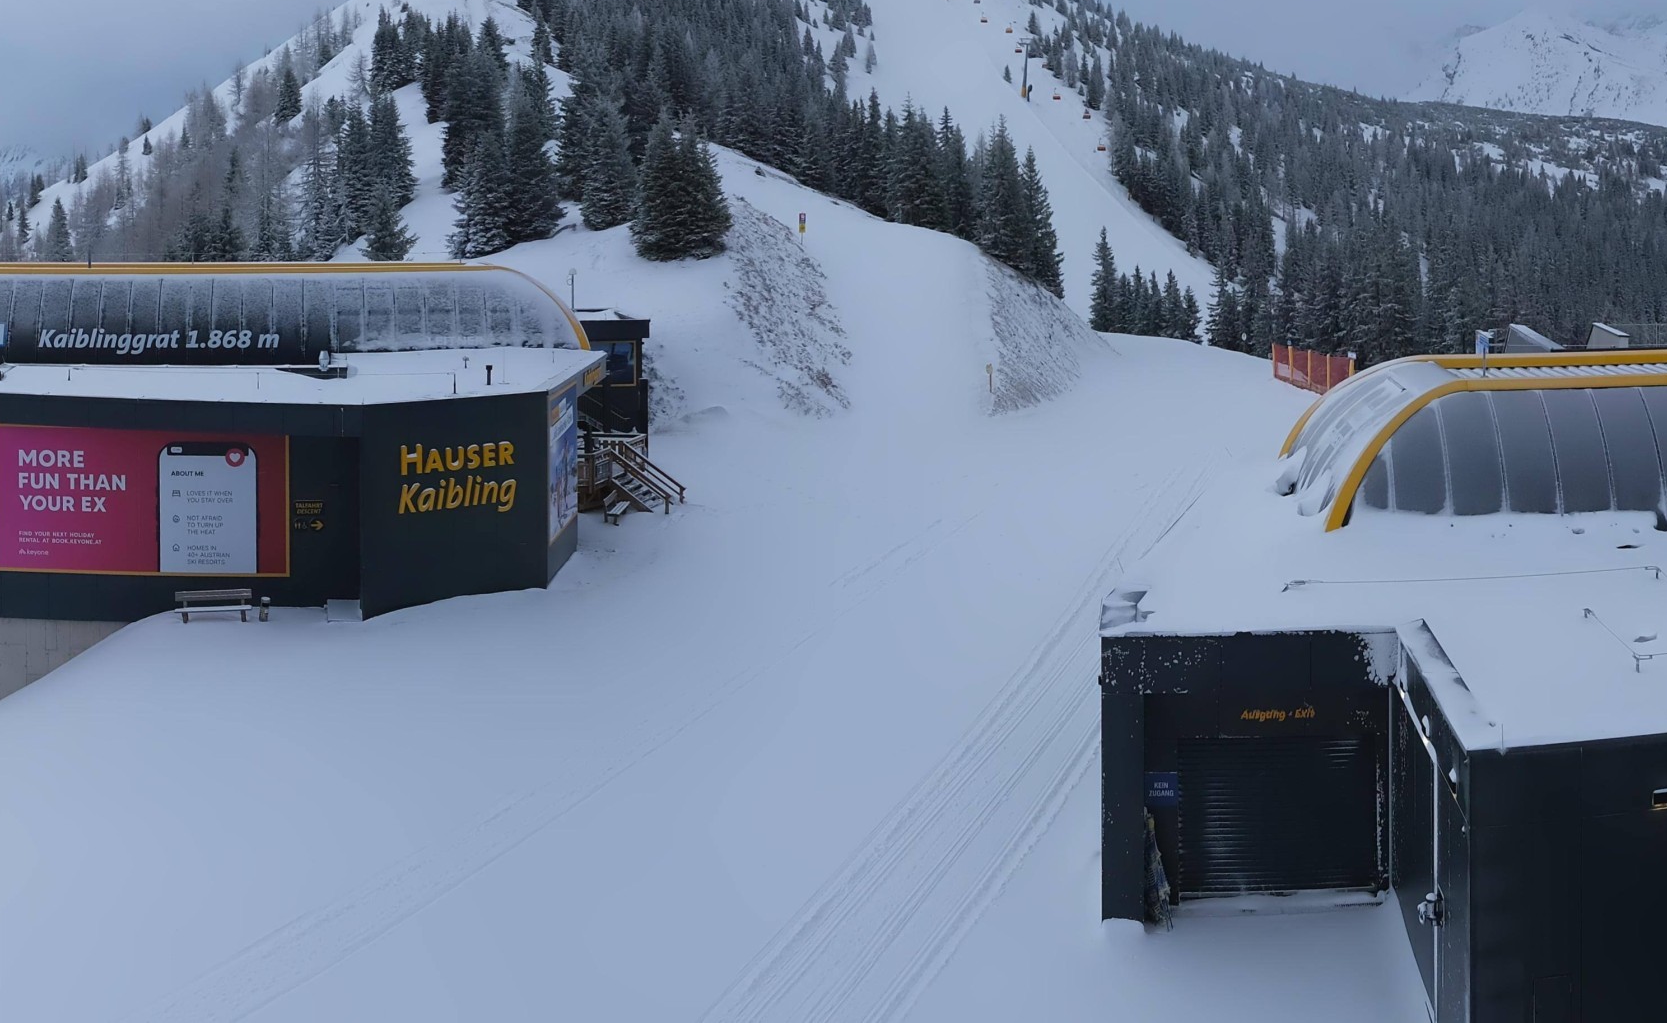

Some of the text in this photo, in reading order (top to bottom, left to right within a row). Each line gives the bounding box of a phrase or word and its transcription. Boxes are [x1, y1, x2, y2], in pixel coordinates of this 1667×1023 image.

[38, 328, 280, 355] Kaiblinggrat 1.868 m
[18, 449, 85, 468] MORE
[401, 441, 515, 476] HAUSER
[18, 472, 126, 491] FUN THAN
[19, 495, 107, 513] YOUR EX
[398, 475, 517, 514] Kaibling
